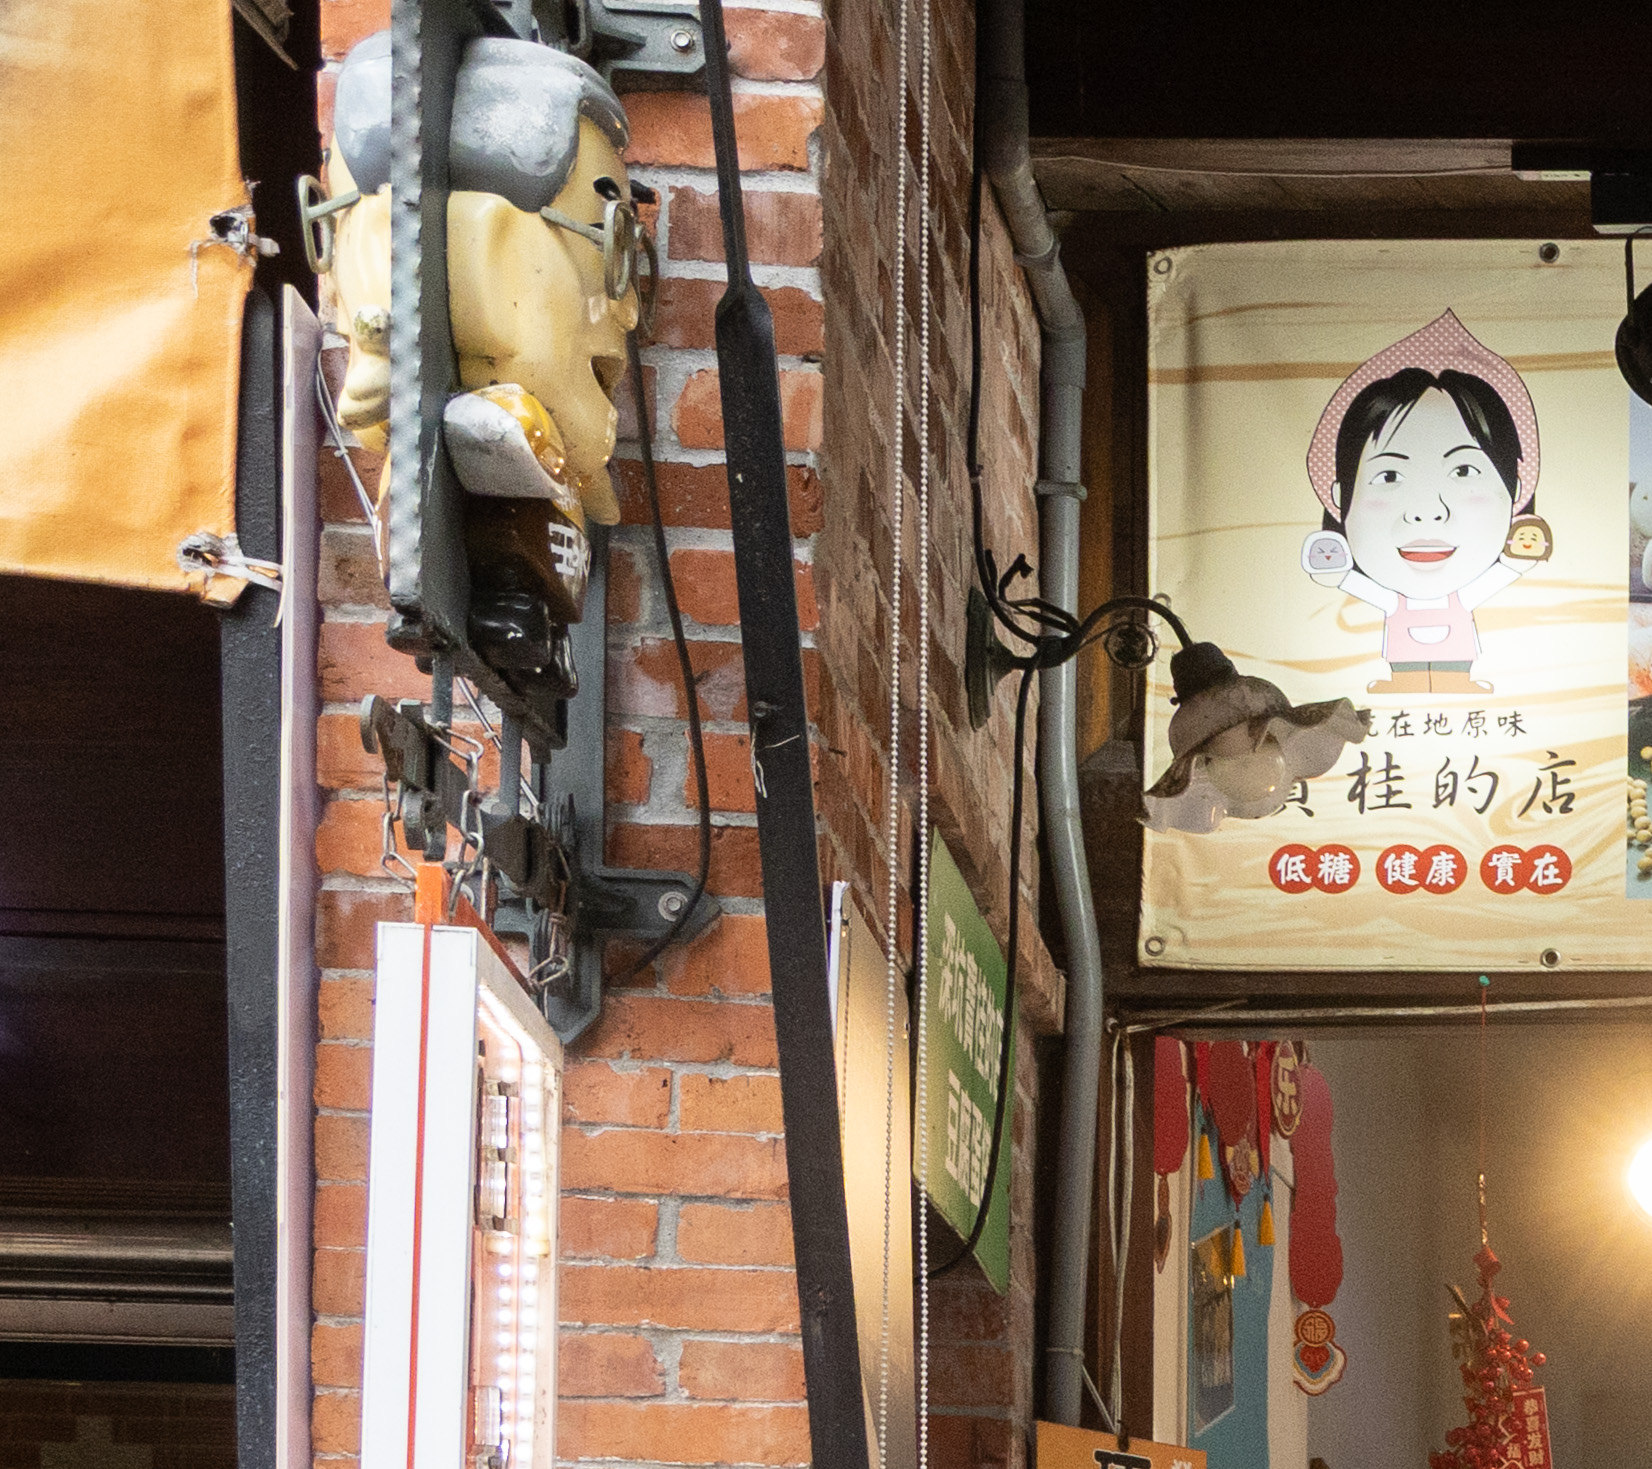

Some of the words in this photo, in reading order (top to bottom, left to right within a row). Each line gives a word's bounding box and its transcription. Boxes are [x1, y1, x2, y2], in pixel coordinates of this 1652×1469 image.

[1276, 851, 1353, 887] 低糖
[1382, 851, 1459, 888] 健康
[1488, 851, 1564, 888] 實在
